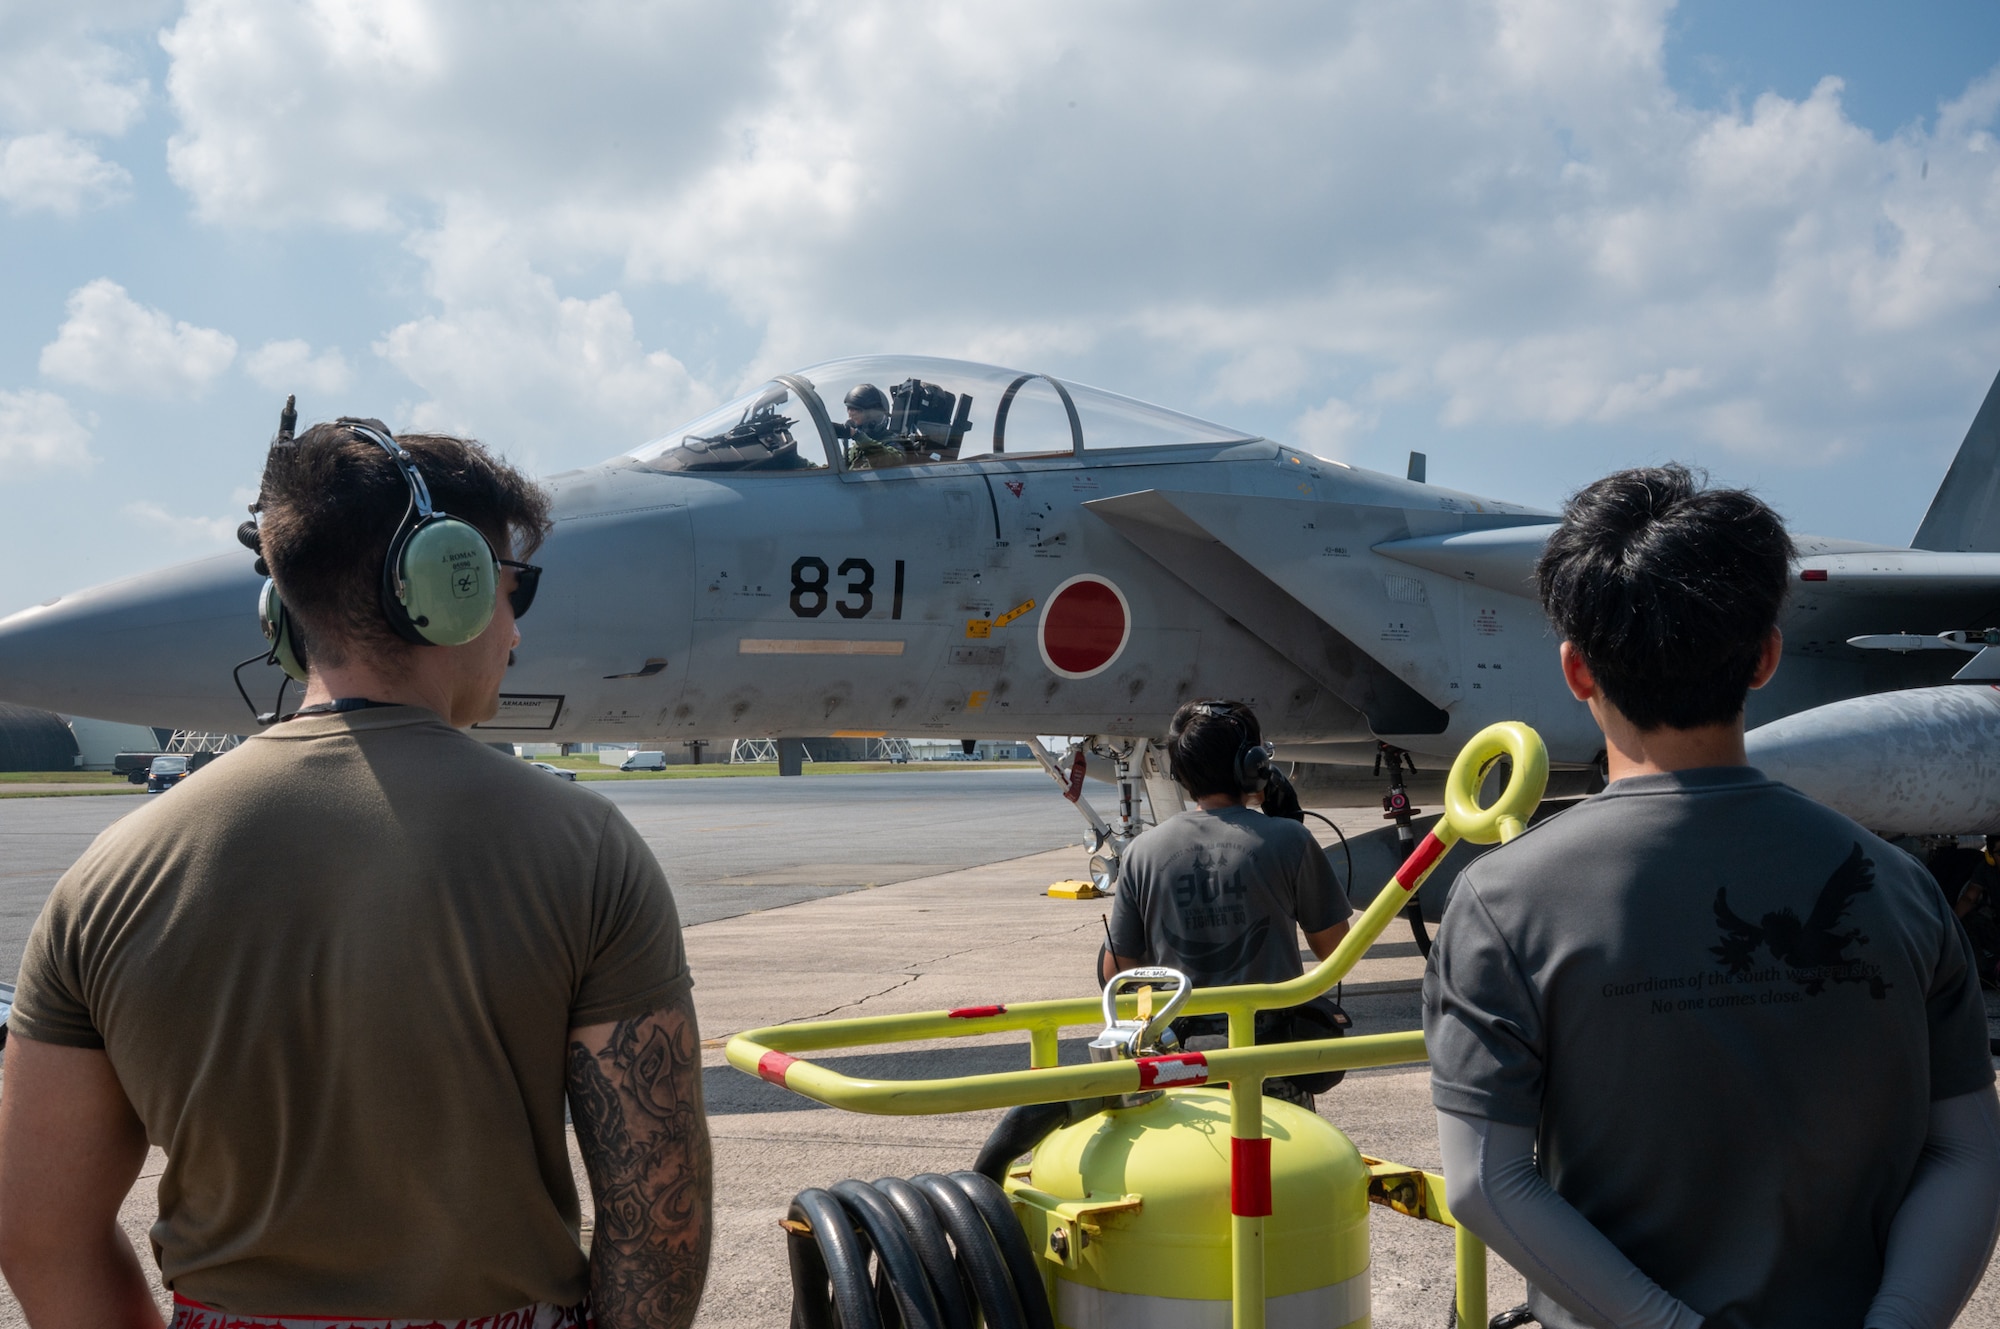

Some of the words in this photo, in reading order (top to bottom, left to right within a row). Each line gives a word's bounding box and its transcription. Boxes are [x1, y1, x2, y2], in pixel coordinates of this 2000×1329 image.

[449, 550, 477, 562] ROMAN
[790, 556, 905, 620] 831
[1177, 868, 1247, 908] 304
[1185, 913, 1228, 930] FIGHTER
[1602, 976, 1685, 997] Guardians
[1688, 971, 1705, 990] of
[1708, 970, 1733, 986] the
[1737, 966, 1781, 984] south
[1650, 999, 1673, 1014] No
[1677, 998, 1704, 1011] one
[1708, 994, 1757, 1009] comes
[1760, 989, 1803, 1005] close.
